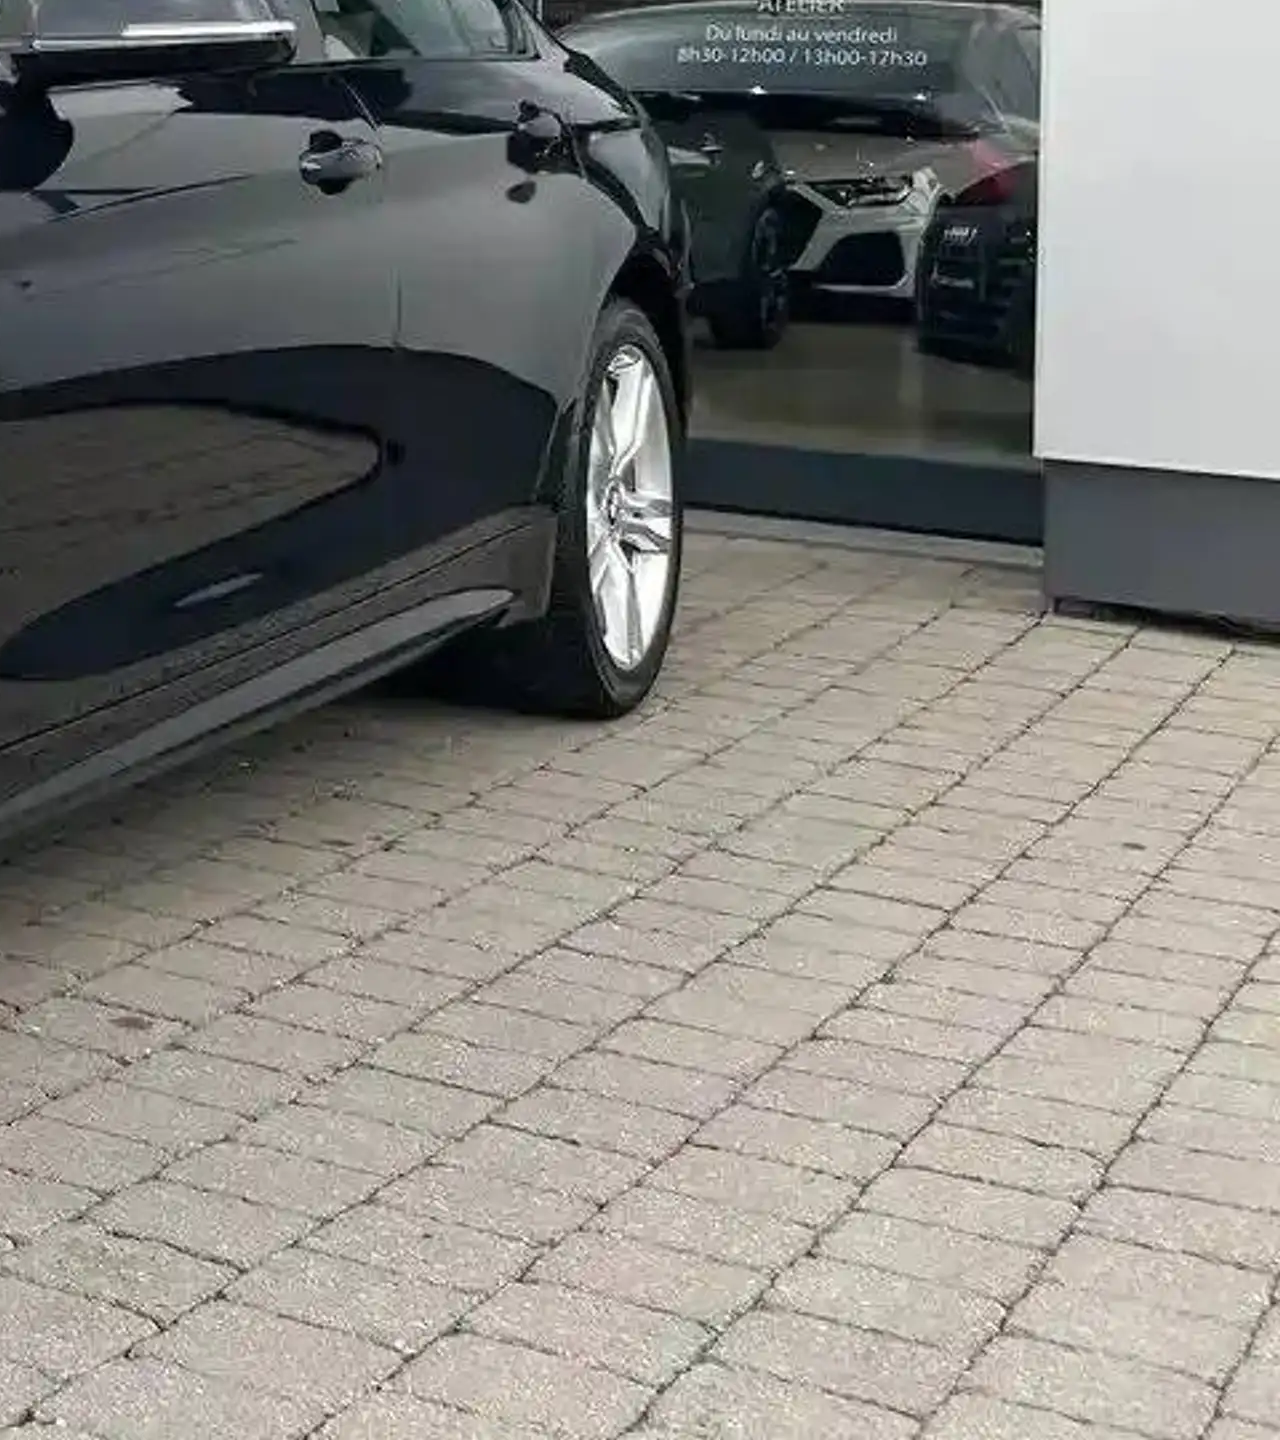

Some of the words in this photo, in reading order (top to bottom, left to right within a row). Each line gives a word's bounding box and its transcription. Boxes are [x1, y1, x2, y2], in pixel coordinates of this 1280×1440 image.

[706, 24, 732, 41] Du
[736, 24, 782, 42] lundi
[786, 30, 809, 43] au
[815, 26, 898, 44] vendredi
